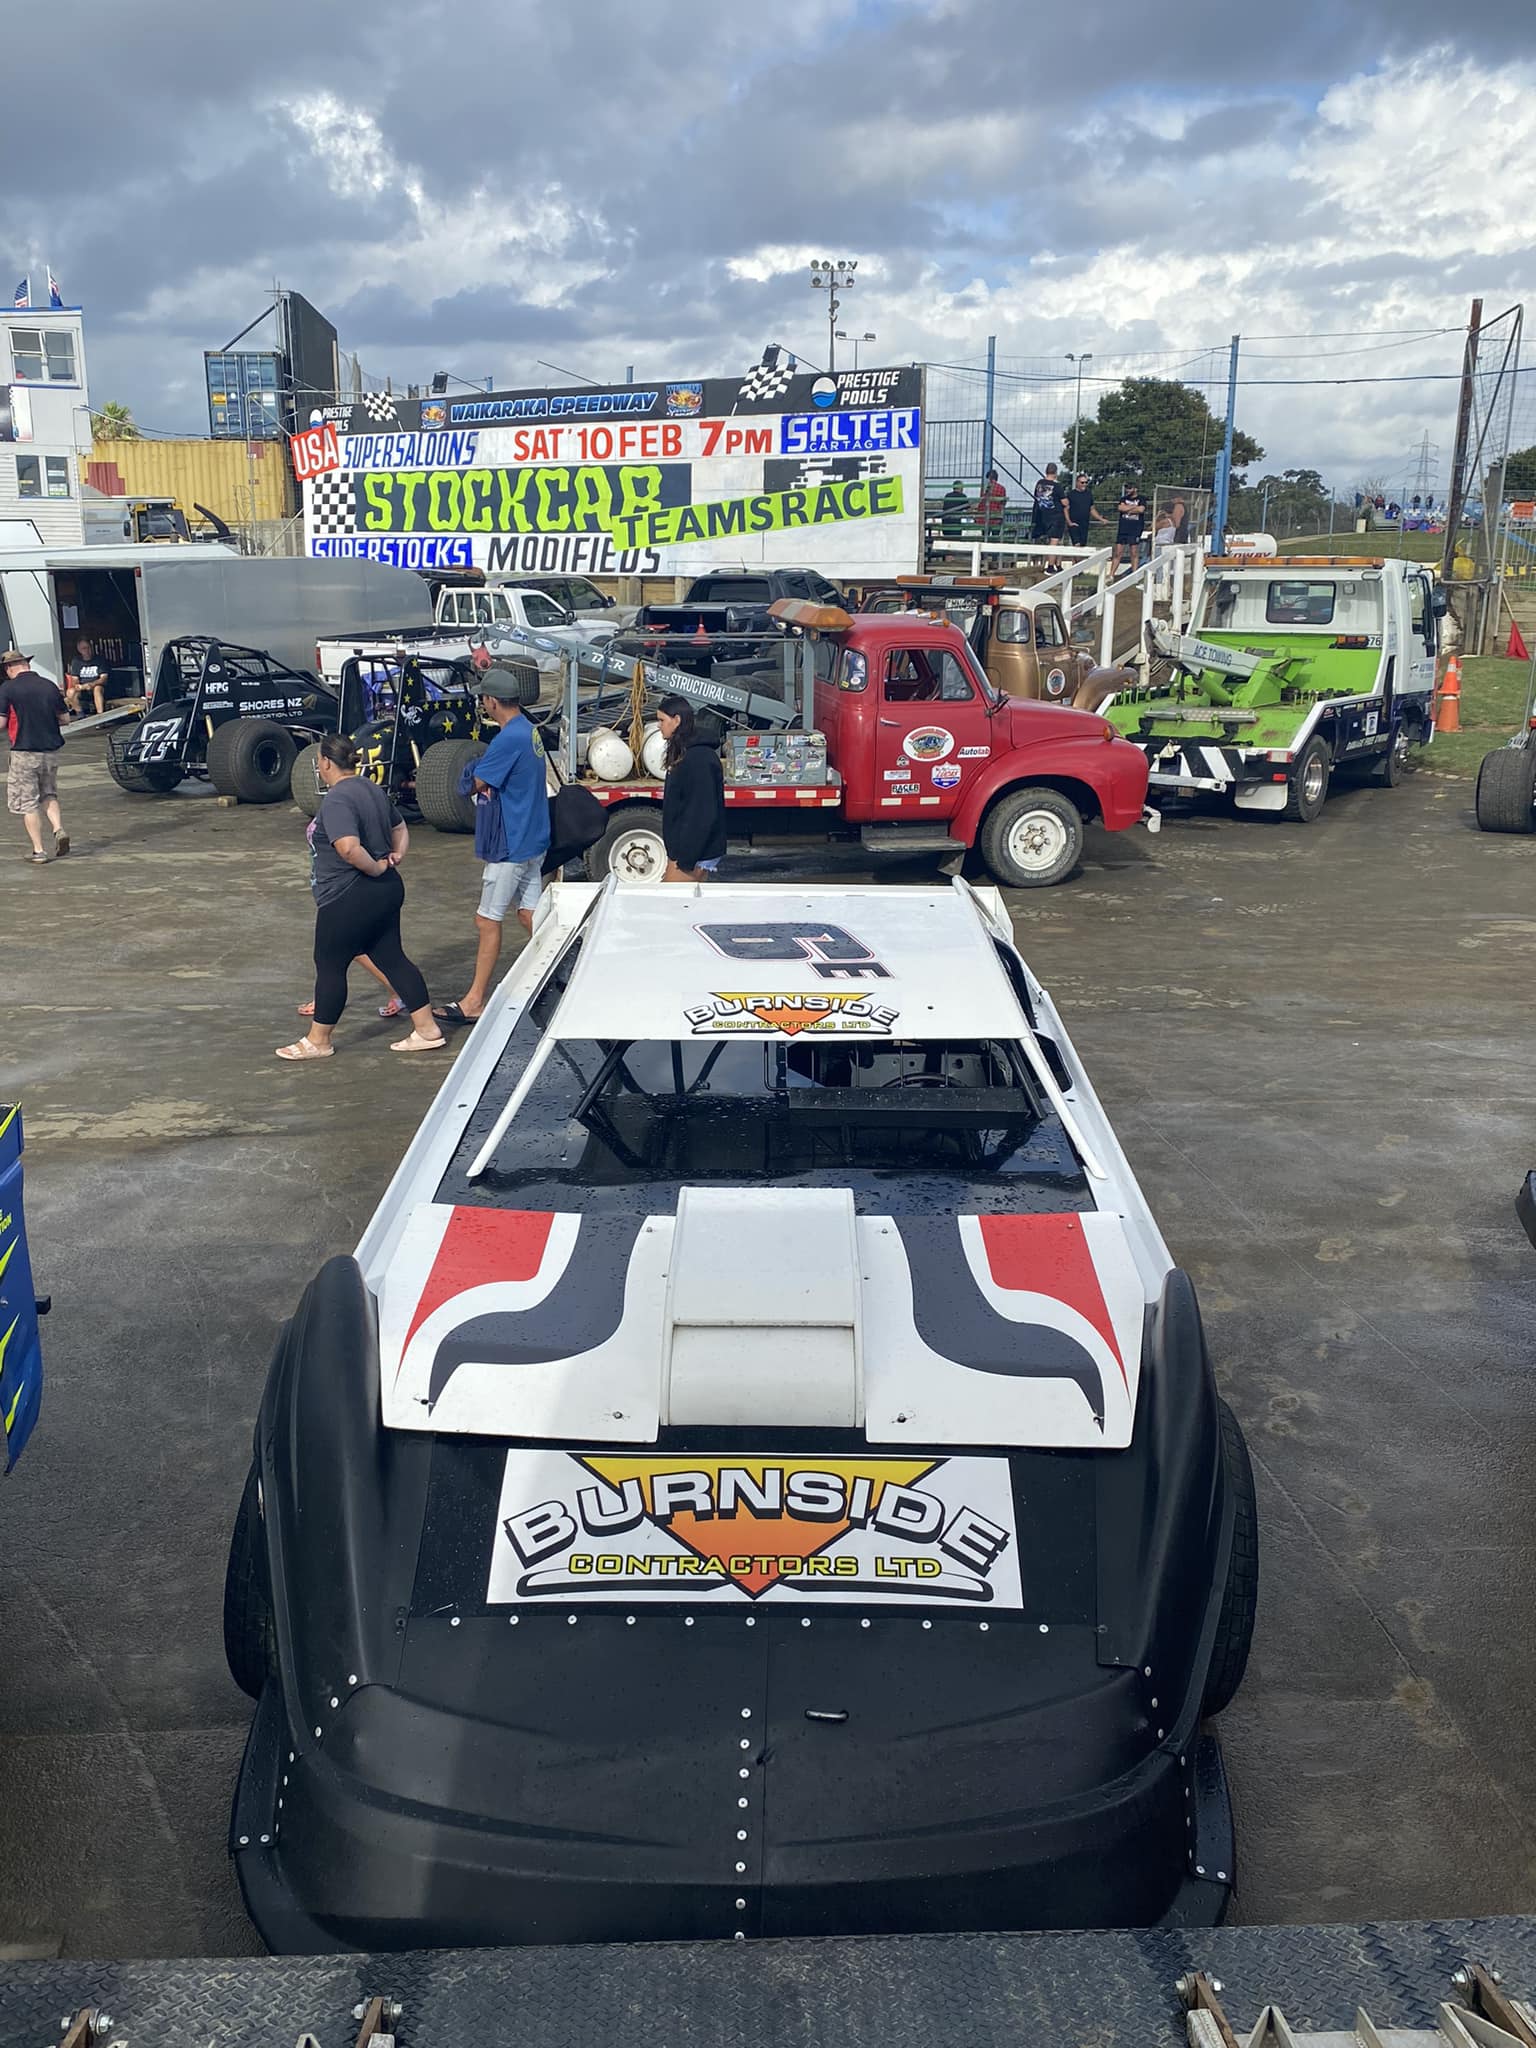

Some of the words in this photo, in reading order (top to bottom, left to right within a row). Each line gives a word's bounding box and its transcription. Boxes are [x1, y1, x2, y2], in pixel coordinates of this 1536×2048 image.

[837, 371, 900, 388] PRESTIGE
[451, 398, 548, 422] WAIKARAKA
[550, 392, 658, 417] SPEEDWAY
[840, 389, 889, 405] POOLS
[322, 406, 353, 419] PRESTIGE
[620, 424, 682, 458] FEB
[698, 420, 772, 457] 7PM
[787, 411, 914, 453] SALTER
[809, 439, 888, 452] CARTAGE
[293, 428, 338, 475] USA
[343, 431, 479, 468] SUPERSALOONS
[364, 465, 662, 533] STOCKCAR
[315, 538, 468, 569] SUPERSTOCKS
[1194, 645, 1207, 659] ACE
[1208, 650, 1232, 667] TOWING
[669, 673, 727, 702] STRUCTURAL
[239, 699, 284, 711] SHORES
[286, 697, 302, 707] NZ
[959, 747, 990, 756] Autolab
[683, 994, 900, 1026] BURNSIDE
[712, 1020, 835, 1029] CONTRACTORS
[842, 1020, 871, 1029] LTD
[503, 1467, 1010, 1577] BURNSIDE
[568, 1553, 859, 1577] CONTRACTORS
[875, 1554, 943, 1577] LTD
